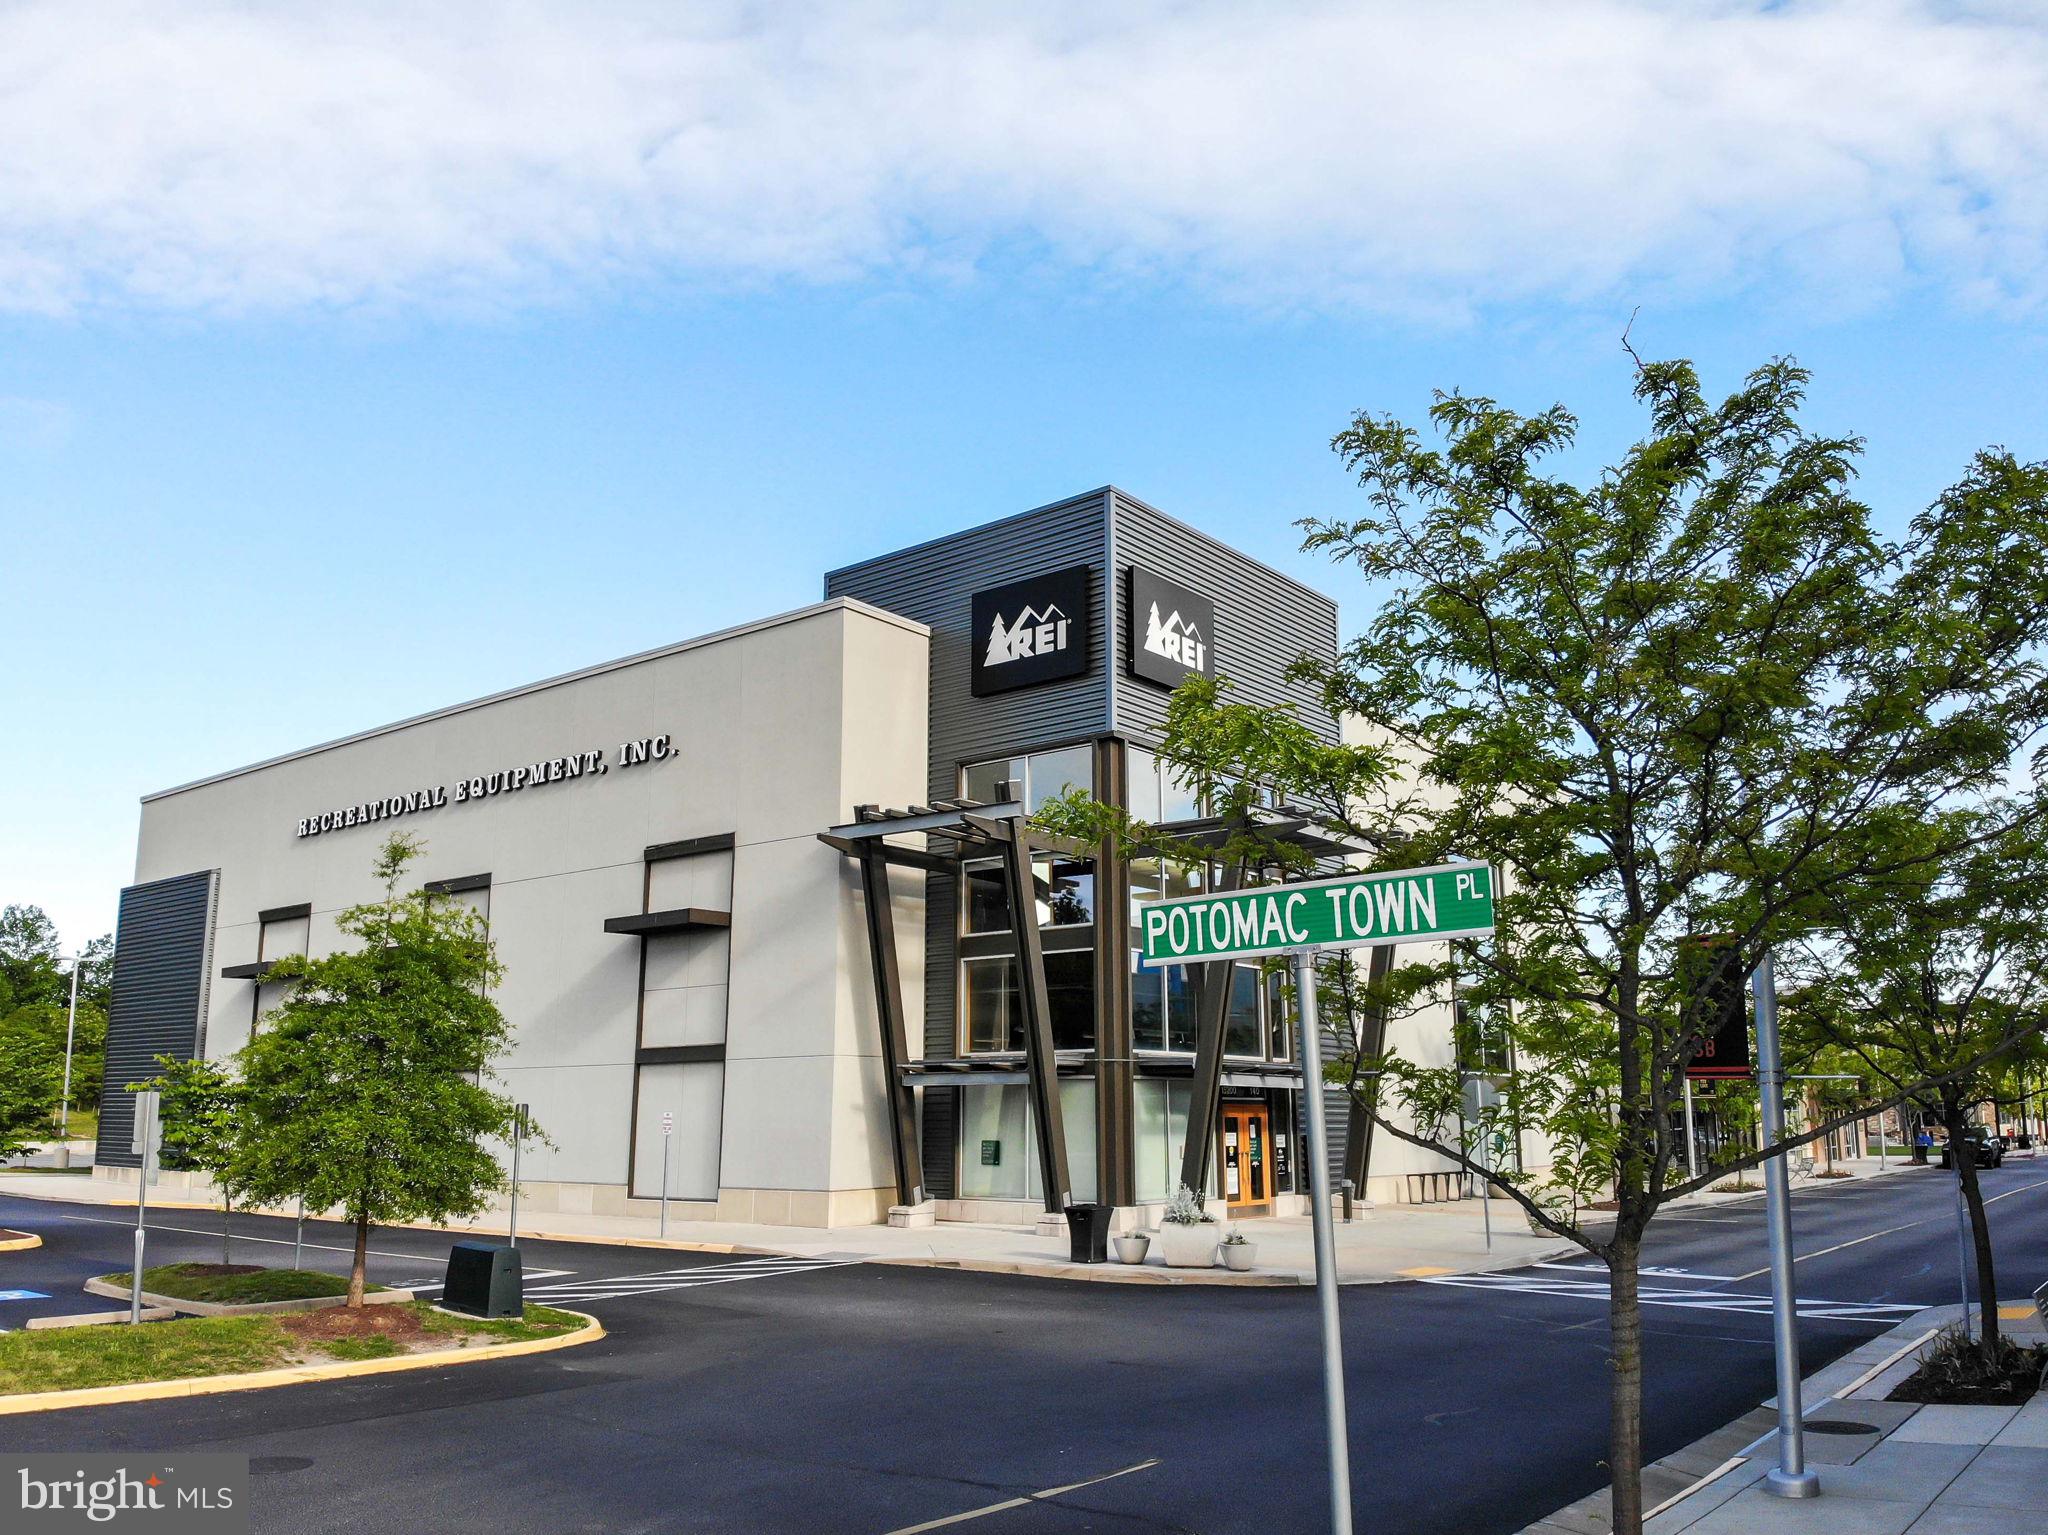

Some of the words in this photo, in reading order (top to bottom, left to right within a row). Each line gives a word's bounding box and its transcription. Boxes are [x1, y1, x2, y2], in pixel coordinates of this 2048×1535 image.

[1013, 619, 1068, 659] REI
[1163, 630, 1204, 671] REI
[297, 786, 446, 838] RECREATIONAL
[454, 750, 608, 802] EQUIPMENT,
[618, 734, 680, 767] INC.
[1147, 892, 1309, 956] POTOMAC
[1325, 877, 1438, 938] TOWN
[1456, 873, 1484, 901] PL
